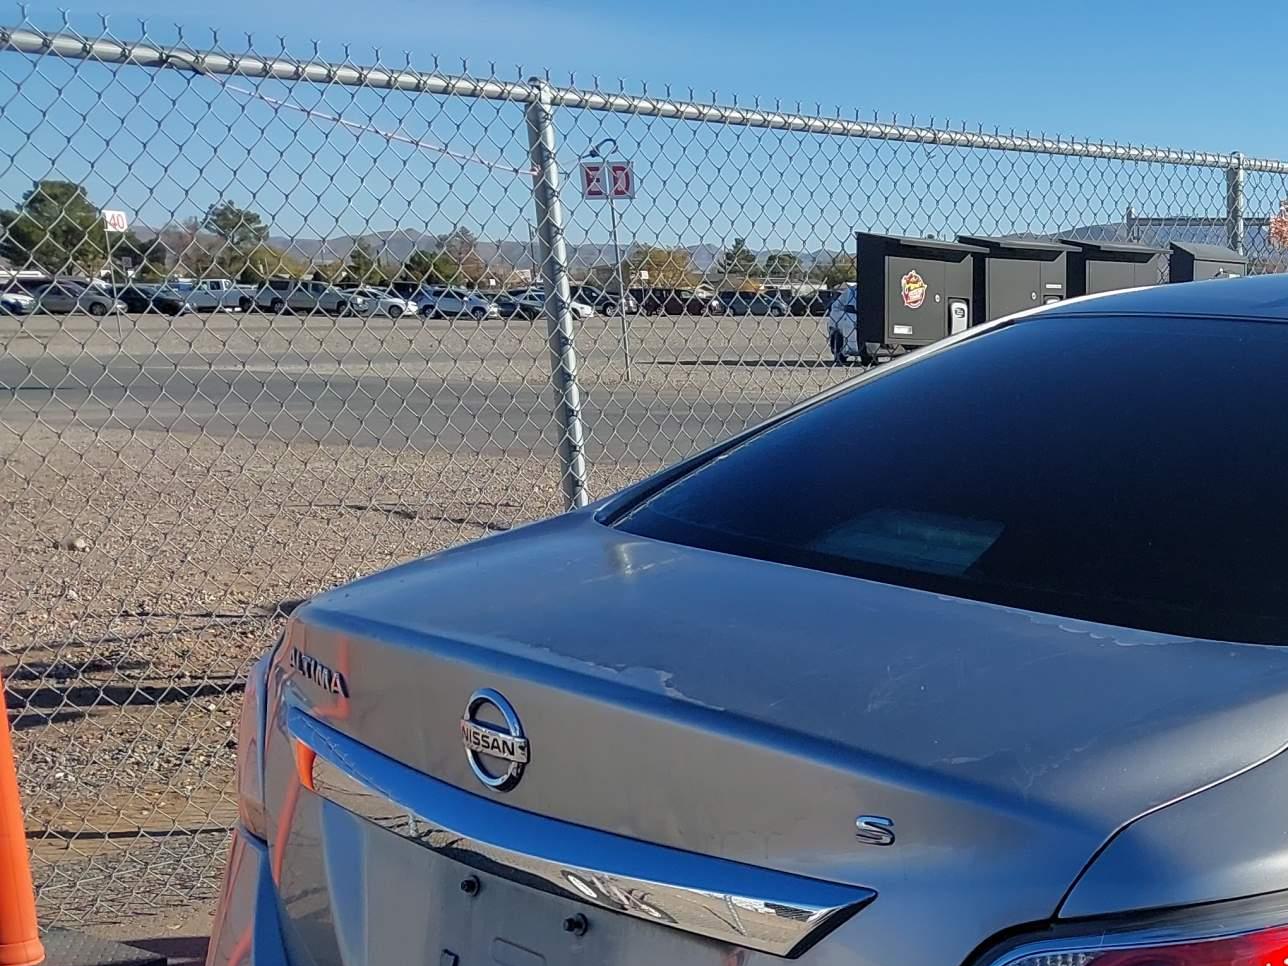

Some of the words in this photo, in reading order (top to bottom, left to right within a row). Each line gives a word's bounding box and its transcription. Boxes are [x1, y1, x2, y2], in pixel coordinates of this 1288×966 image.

[289, 646, 350, 698] ALTIMA
[461, 725, 515, 757] NISSAN
[856, 815, 896, 847] S
